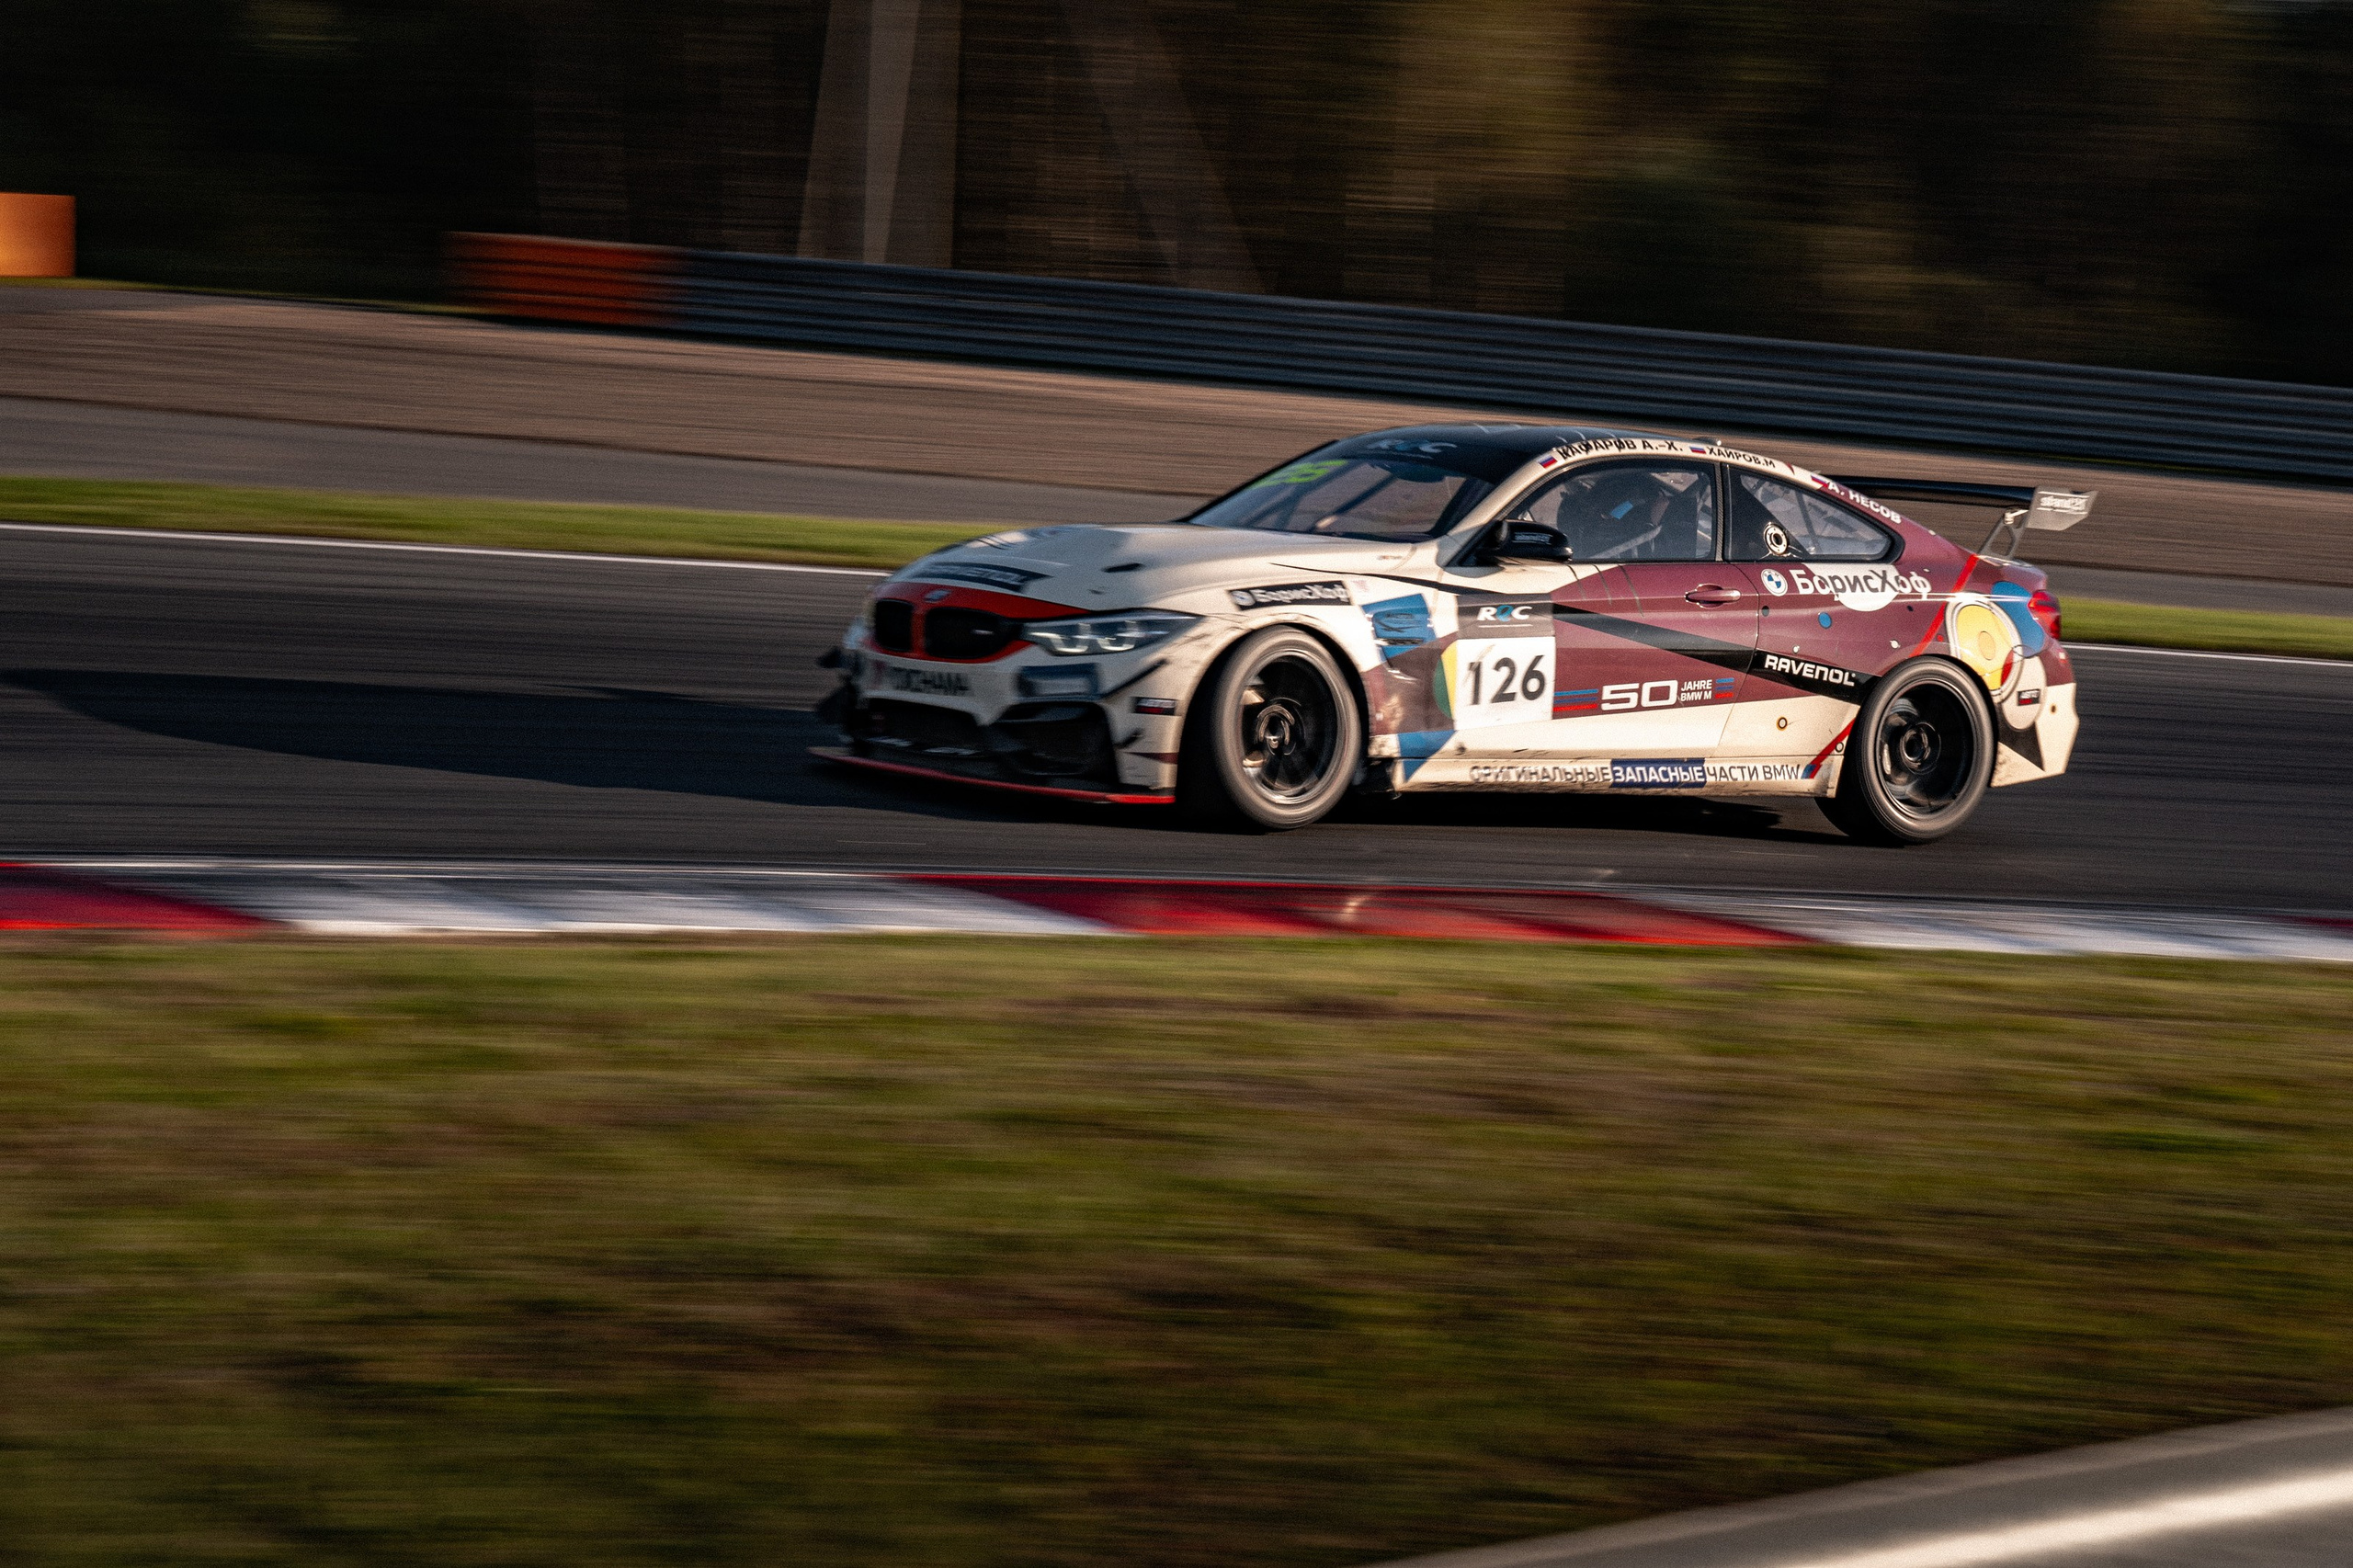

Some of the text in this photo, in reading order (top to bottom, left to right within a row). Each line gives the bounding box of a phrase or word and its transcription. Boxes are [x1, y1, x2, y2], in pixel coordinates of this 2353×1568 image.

[1848, 490, 1902, 524] НЕСОВ
[1789, 569, 1932, 601] БорисХоф
[1468, 654, 1546, 706] 126
[1680, 679, 1712, 692] JAHRE
[1765, 654, 1855, 687] RAVENOL
[1601, 679, 1678, 710] 50
[1680, 690, 1712, 702] BMW M
[1612, 766, 1705, 782] ЗАПАСНЫЕ
[1706, 765, 1759, 782] ЧАСТИ
[1762, 764, 1801, 780] BMW
